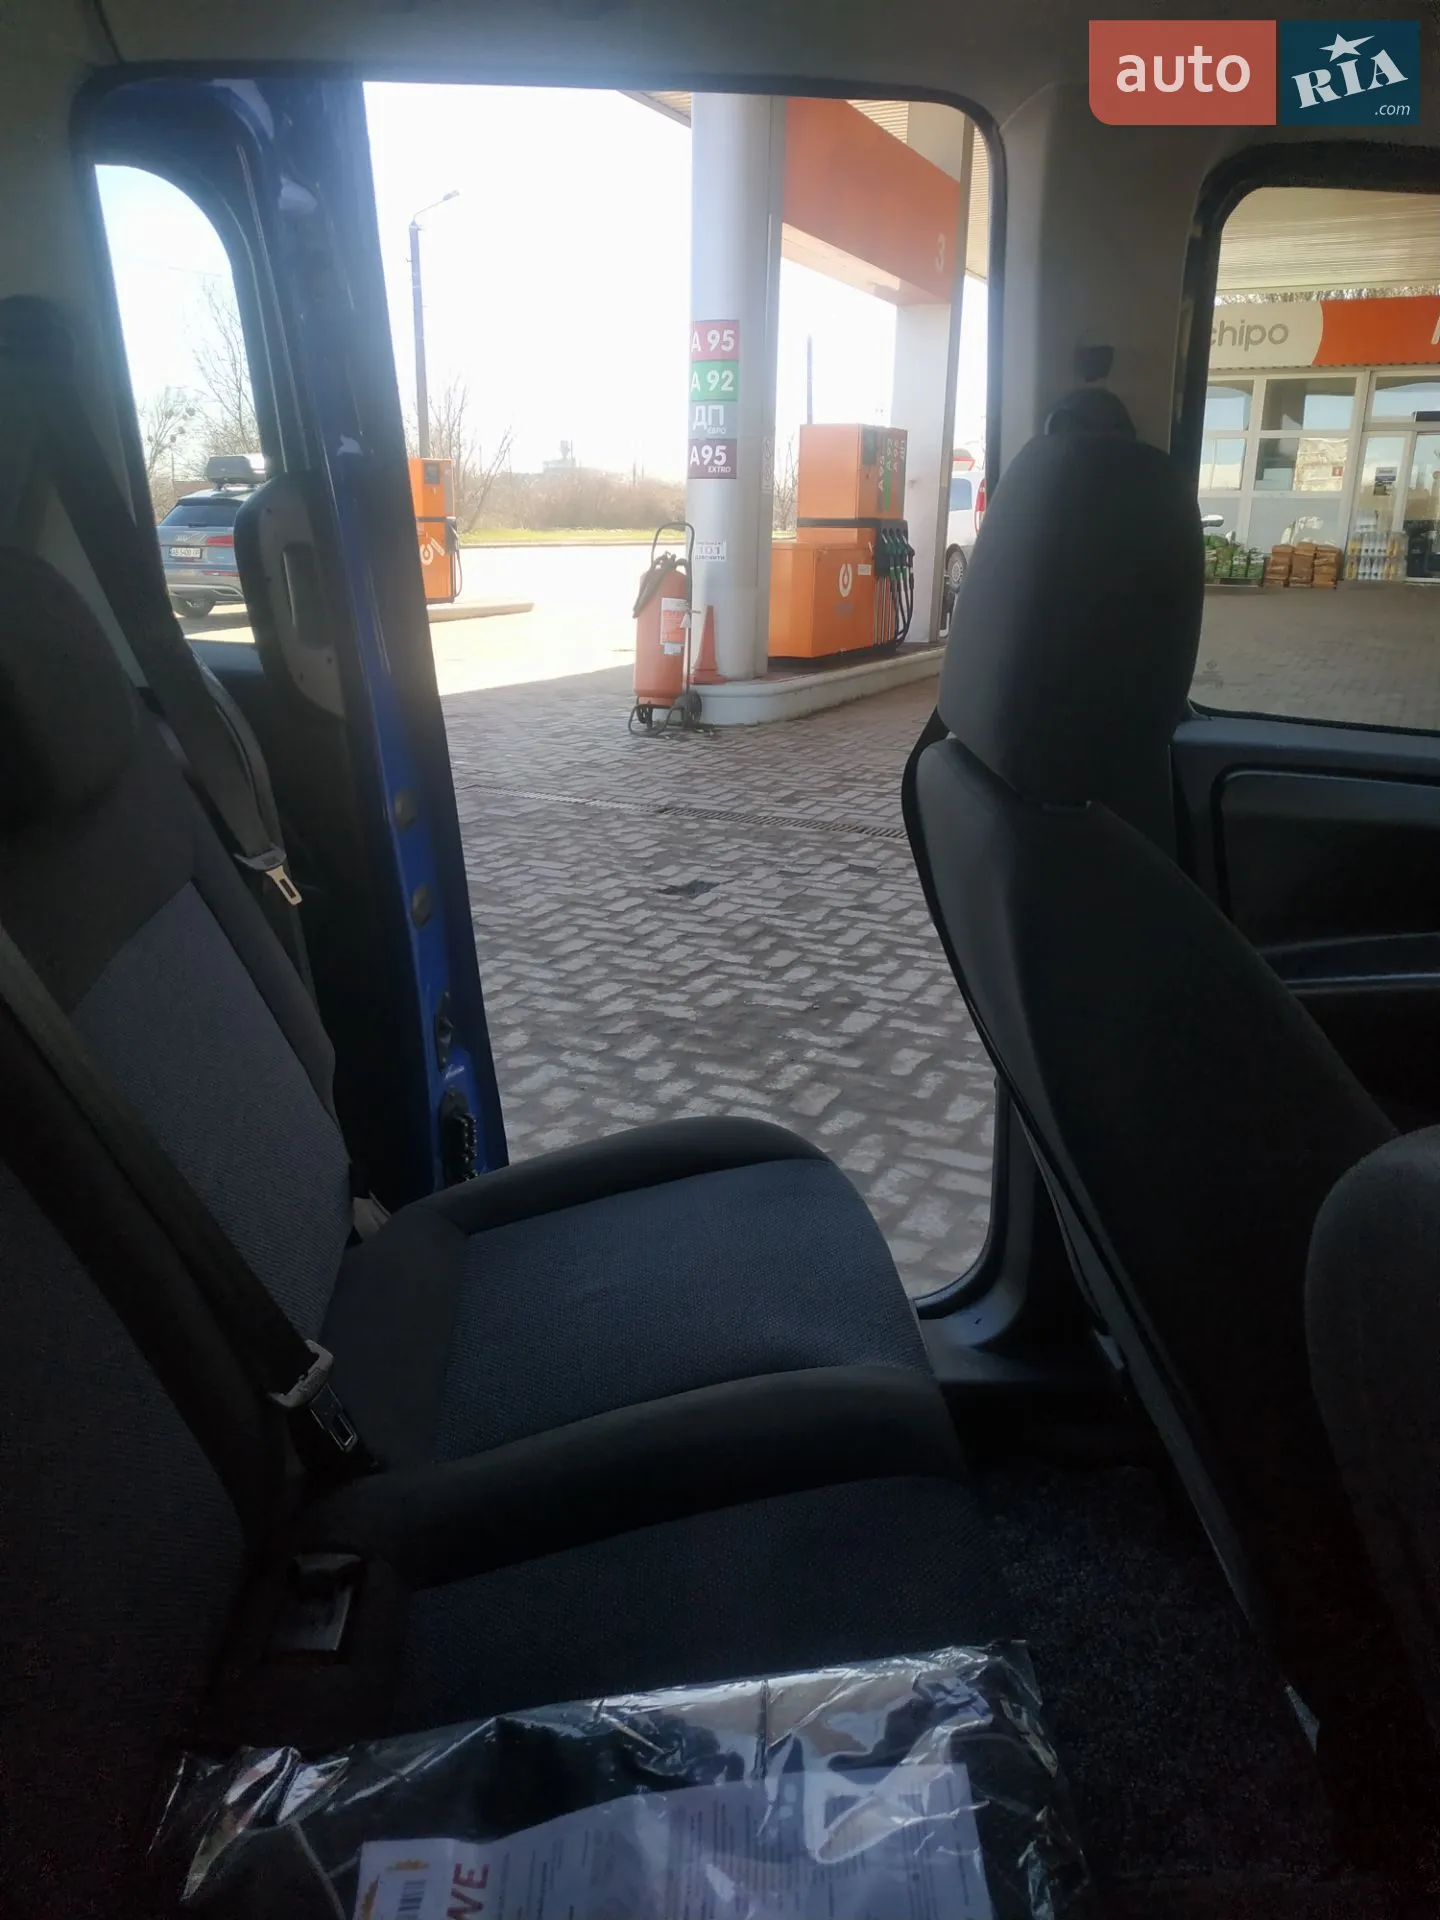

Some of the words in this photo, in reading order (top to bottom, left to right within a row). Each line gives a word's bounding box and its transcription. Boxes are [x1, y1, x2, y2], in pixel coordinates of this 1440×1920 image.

[935, 232, 946, 273] 3
[706, 329, 735, 353] 95
[706, 370, 735, 392] 92
[692, 405, 725, 431] ДП
